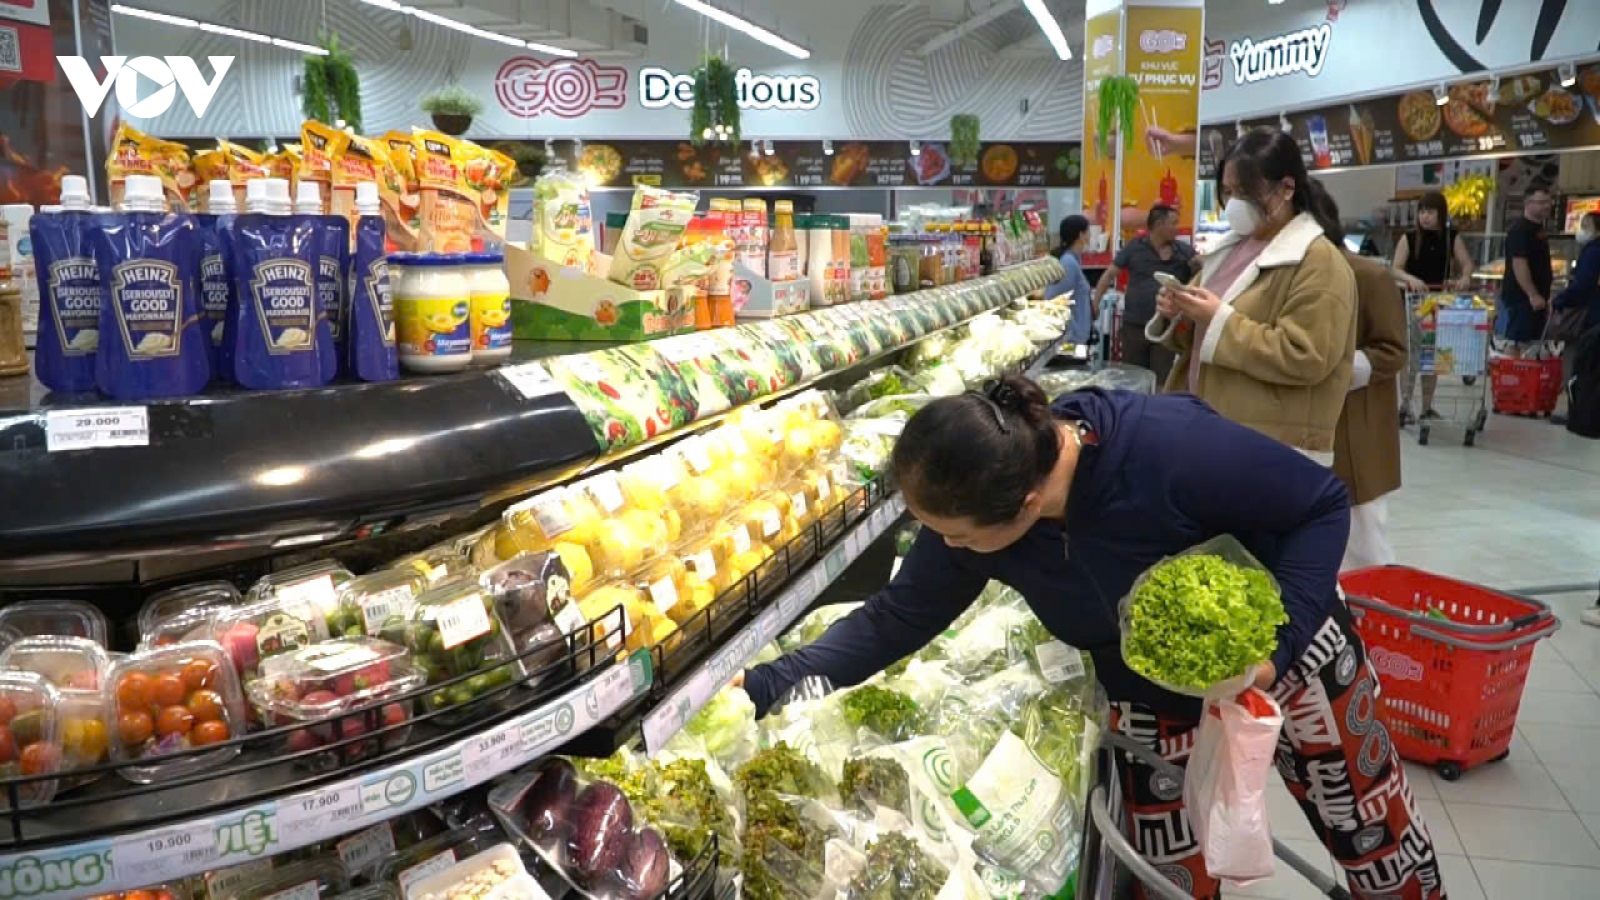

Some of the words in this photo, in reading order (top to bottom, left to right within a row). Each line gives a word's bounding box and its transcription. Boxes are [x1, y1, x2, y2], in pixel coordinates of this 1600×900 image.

[1230, 23, 1332, 85] Yummy
[640, 69, 820, 109] Deious
[123, 268, 170, 284] HEINZ
[264, 266, 305, 281] HEINZ
[130, 301, 168, 312] GOOD
[270, 296, 305, 309] GOOD
[303, 792, 340, 811] 17.900
[147, 832, 192, 851] 19.900
[0, 853, 104, 900] ÔNG
